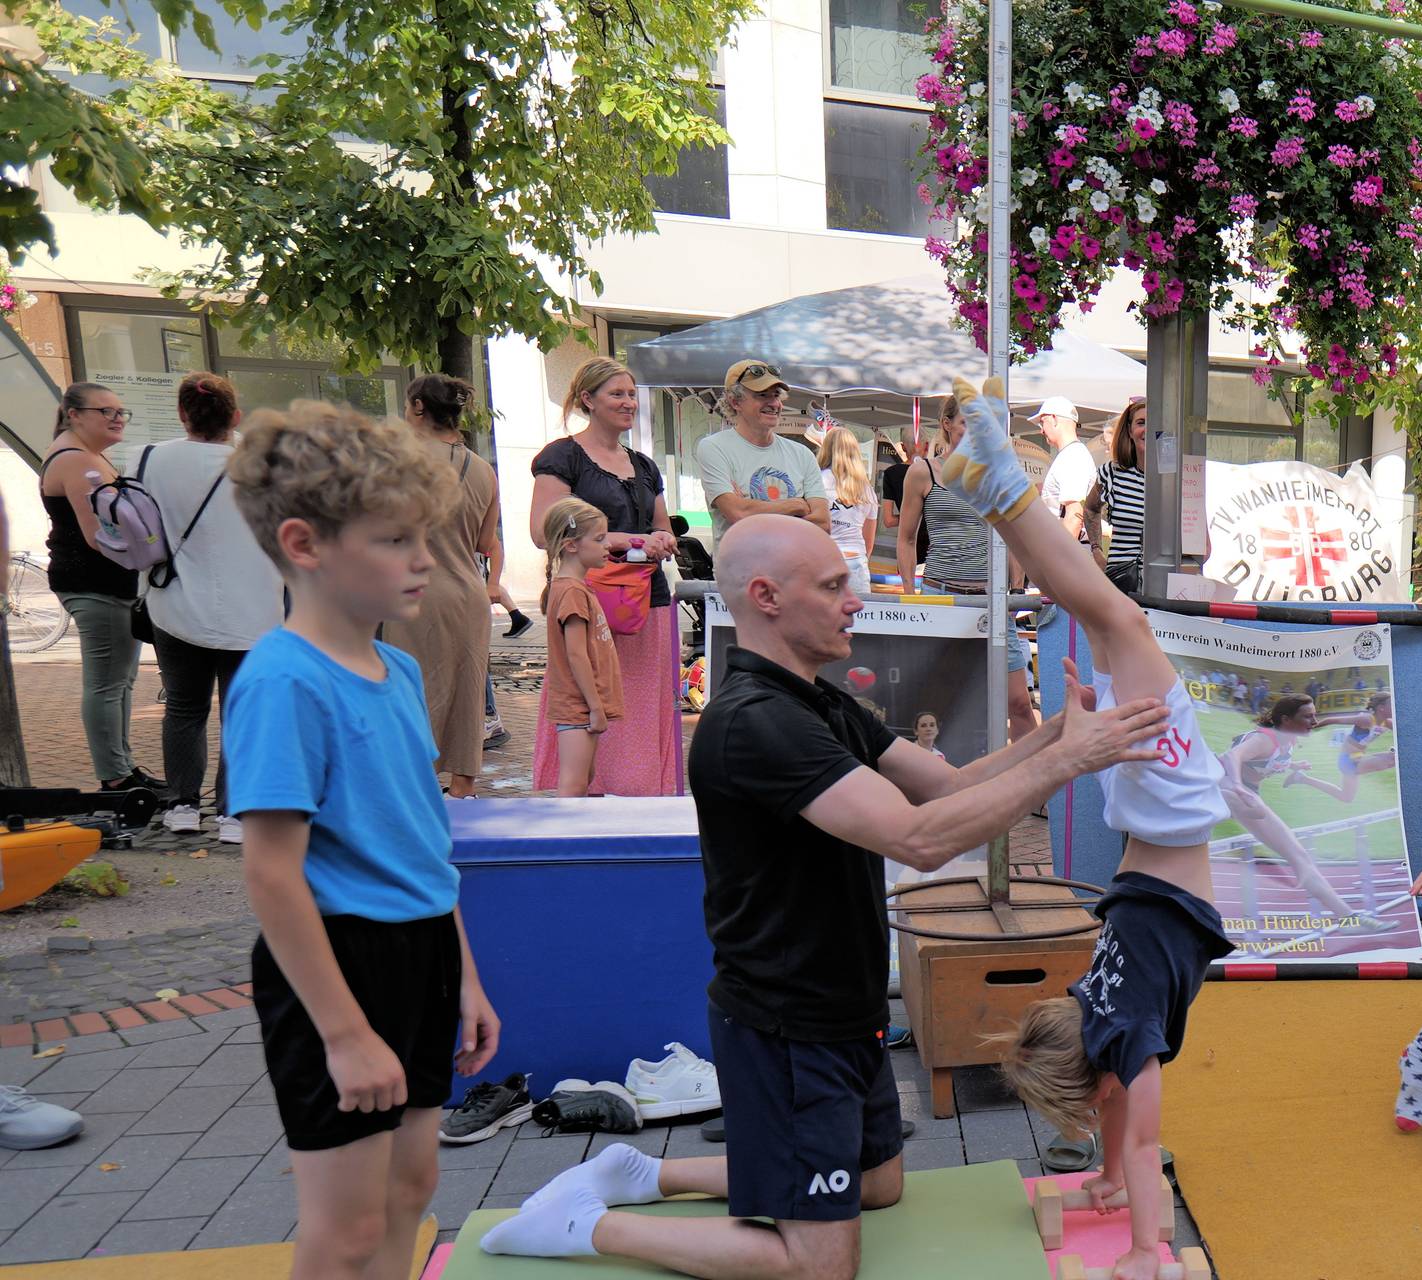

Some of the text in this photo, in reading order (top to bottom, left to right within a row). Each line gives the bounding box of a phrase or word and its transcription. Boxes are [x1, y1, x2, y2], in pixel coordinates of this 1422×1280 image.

[1233, 531, 1372, 555] 18 80
[879, 610, 906, 621] 1880
[1153, 627, 1210, 646] urnverein
[1213, 637, 1296, 659] Wanheimerort
[1299, 647, 1322, 659] 1880
[1263, 912, 1333, 930] Hürden
[1339, 916, 1361, 929] zu
[1233, 937, 1326, 953] erwinden!
[808, 1169, 851, 1196] AO
